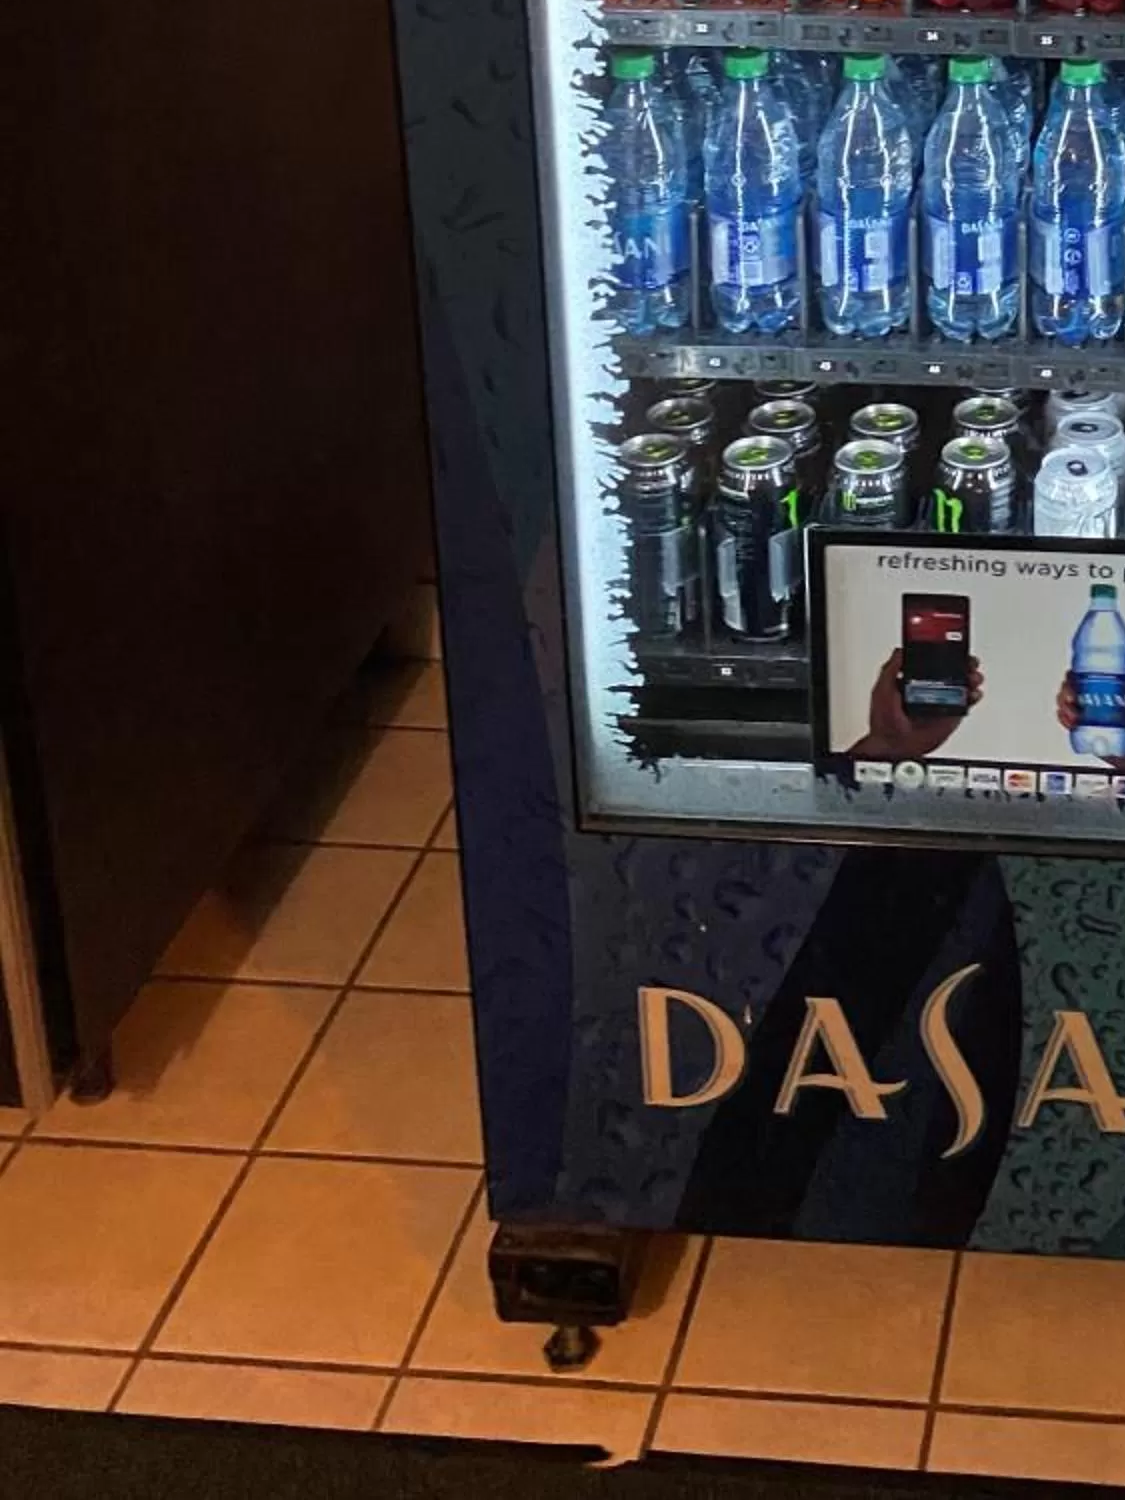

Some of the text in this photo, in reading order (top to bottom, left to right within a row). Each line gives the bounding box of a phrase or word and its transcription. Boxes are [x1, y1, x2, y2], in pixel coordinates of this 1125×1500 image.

[877, 552, 1007, 577] refreshing
[1016, 561, 1080, 581] ways
[1088, 563, 1114, 580] to
